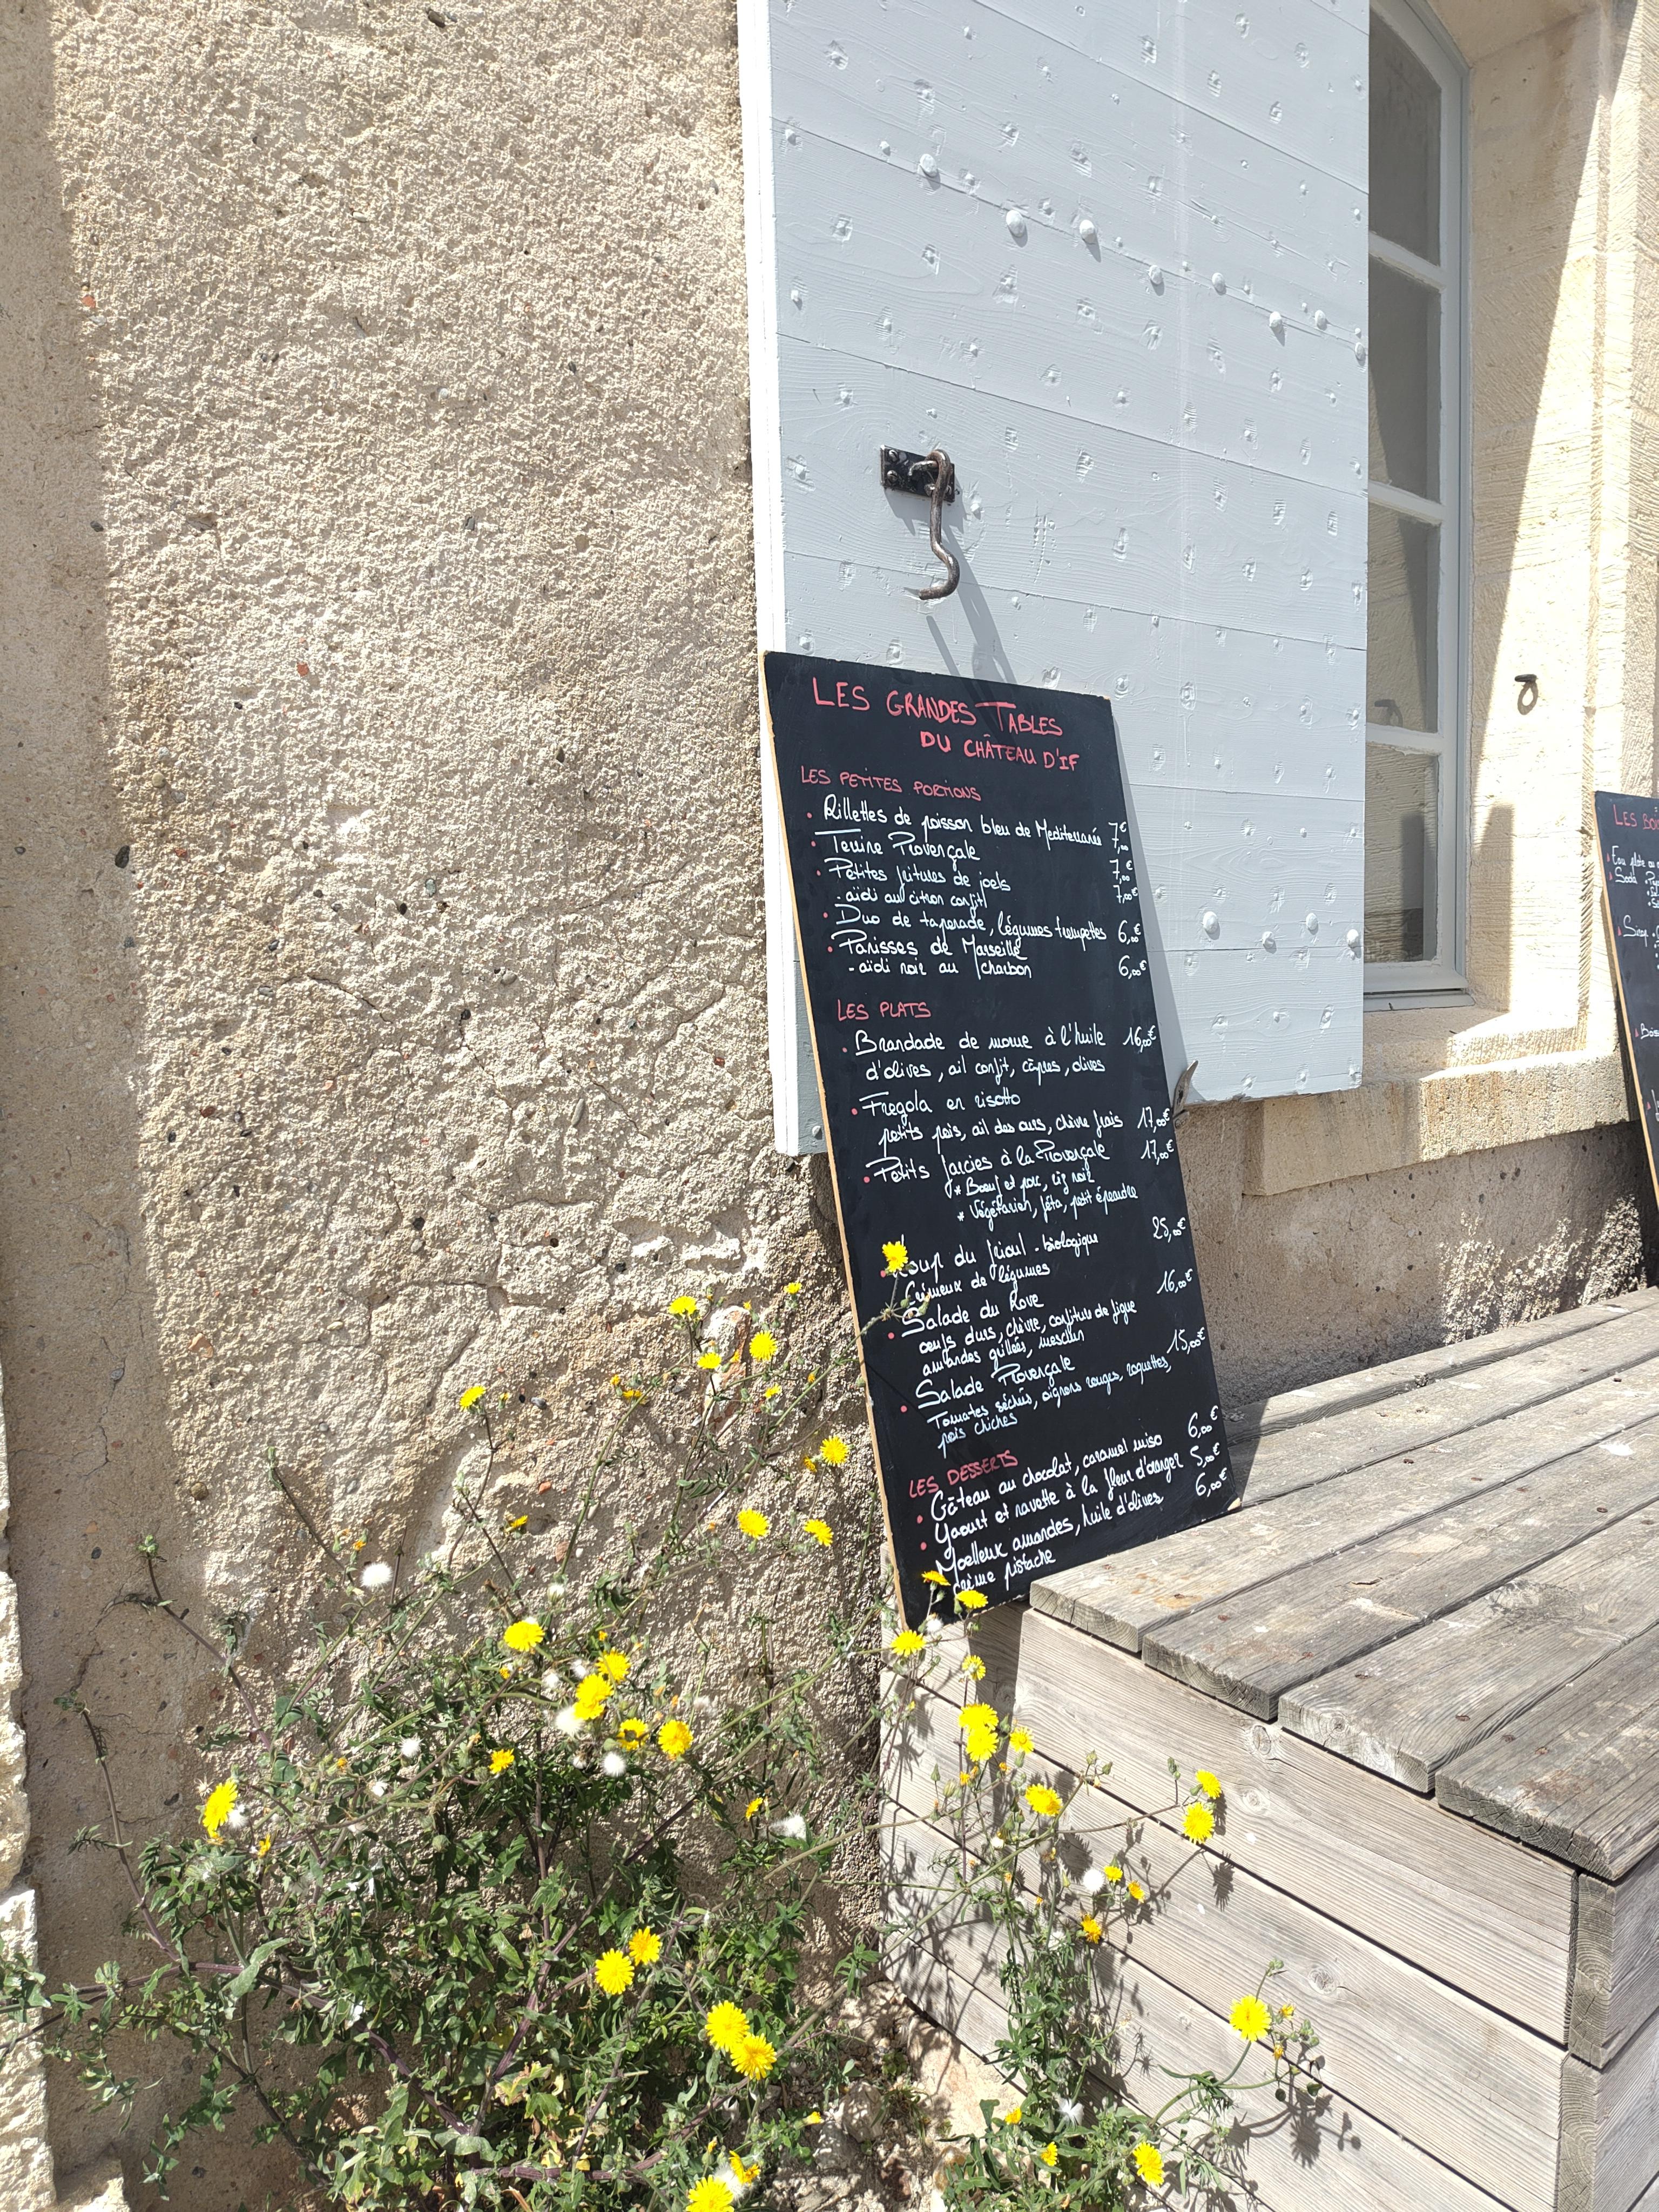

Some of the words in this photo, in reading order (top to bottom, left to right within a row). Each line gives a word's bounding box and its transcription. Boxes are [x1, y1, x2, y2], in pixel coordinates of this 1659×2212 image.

[813, 677, 870, 711] LES
[887, 690, 976, 725] GRANDES
[920, 731, 950, 752] DU
[964, 734, 1036, 765] CHÂTEAU
[1044, 748, 1080, 771] D'IF
[801, 766, 831, 785] LES
[840, 768, 902, 793] PETITES
[914, 780, 981, 801] PORTIONS
[824, 794, 887, 823] Rillettes
[894, 806, 912, 825] de
[922, 813, 973, 842] poisson
[981, 814, 1010, 836] bleu
[1015, 821, 1031, 838] de
[1613, 804, 1637, 827] LES
[815, 828, 883, 854] Terrine
[888, 832, 980, 871] Provençale
[1611, 845, 1627, 866] Eau
[1629, 852, 1646, 876] plate
[824, 858, 887, 881] Petites
[896, 864, 946, 903] fritures
[954, 871, 970, 886] de
[1615, 866, 1638, 884] Soda
[884, 893, 901, 903] au
[909, 891, 944, 905] citron
[950, 892, 983, 918] confit
[834, 903, 880, 925] Duo
[892, 911, 912, 928] de
[998, 911, 1053, 949] légumes
[1055, 916, 1107, 952] trempettes
[1623, 915, 1649, 947] Sirop
[831, 929, 918, 955] Panisses
[930, 935, 953, 956] de
[962, 934, 1027, 980] Marseille
[900, 957, 927, 975] noir
[939, 962, 959, 975] au
[981, 960, 1031, 978] charbon
[838, 999, 869, 1021] LES
[880, 1001, 932, 1019] PLATS
[855, 1029, 945, 1056] Brandade
[959, 1031, 979, 1049] de
[989, 1034, 1033, 1049] morue
[1045, 1026, 1056, 1046] à
[1061, 1022, 1105, 1046] l'huile
[948, 1055, 966, 1076] ail
[975, 1057, 1015, 1085] confit,
[1073, 1055, 1105, 1072] olives
[859, 1089, 933, 1126] Fregola
[947, 1097, 965, 1110] en
[975, 1087, 1020, 1108] risotto
[879, 1122, 923, 1158] petits
[932, 1123, 967, 1154] pois,
[972, 1118, 989, 1136] ail
[994, 1118, 1015, 1133] des
[1019, 1118, 1052, 1135] ours,
[1056, 1114, 1090, 1130] chèvre
[1093, 1110, 1123, 1138] frais
[865, 1156, 930, 1183] Petits
[941, 1155, 993, 1198] farcies
[1001, 1149, 1012, 1166] à
[1016, 1145, 1035, 1166] la
[1034, 1139, 1110, 1171] Provençale
[1004, 1174, 1016, 1190] et
[1052, 1171, 1069, 1195] riz
[1071, 1167, 1095, 1183] noir
[1070, 1189, 1092, 1220] petit
[1096, 1182, 1138, 1215] épeautre
[955, 1244, 976, 1266] du
[1042, 1230, 1099, 1257] biologique
[971, 1271, 987, 1289] de
[999, 1263, 1050, 1294] légumes
[901, 1304, 970, 1337] Salade
[980, 1299, 999, 1319] du
[1009, 1293, 1044, 1311] Rove
[1049, 1306, 1092, 1333] confiture
[1095, 1303, 1109, 1318] de
[1110, 1299, 1137, 1325] figue
[922, 1348, 981, 1376] amandes
[1038, 1329, 1084, 1349] mesclun
[915, 1375, 984, 1410] Salade
[991, 1355, 1075, 1387] Provençale
[927, 1403, 989, 1429] Tomates
[1042, 1386, 1082, 1409] oignons
[1086, 1371, 1123, 1395] rouges,
[1127, 1354, 1171, 1385] roquettes,
[938, 1427, 967, 1459] pois
[974, 1412, 1017, 1435] chiches
[909, 1475, 939, 1499] LES
[947, 1449, 1019, 1485] DESSERTS
[931, 1486, 990, 1521] Gâteau
[999, 1479, 1016, 1495] au
[1083, 1438, 1128, 1468] caramel
[1134, 1432, 1162, 1452] miso
[935, 1509, 988, 1559] Yaourt
[995, 1502, 1009, 1523] et
[1015, 1489, 1060, 1518] navette
[1066, 1482, 1076, 1500] à
[1082, 1475, 1098, 1496] la
[1104, 1467, 1134, 1501] fleur
[1136, 1453, 1184, 1483] d'oranger
[935, 1541, 1008, 1582] Moelleux
[1082, 1501, 1112, 1527] huile
[954, 1571, 996, 1596] crème
[1005, 1548, 1056, 1591] pistache
